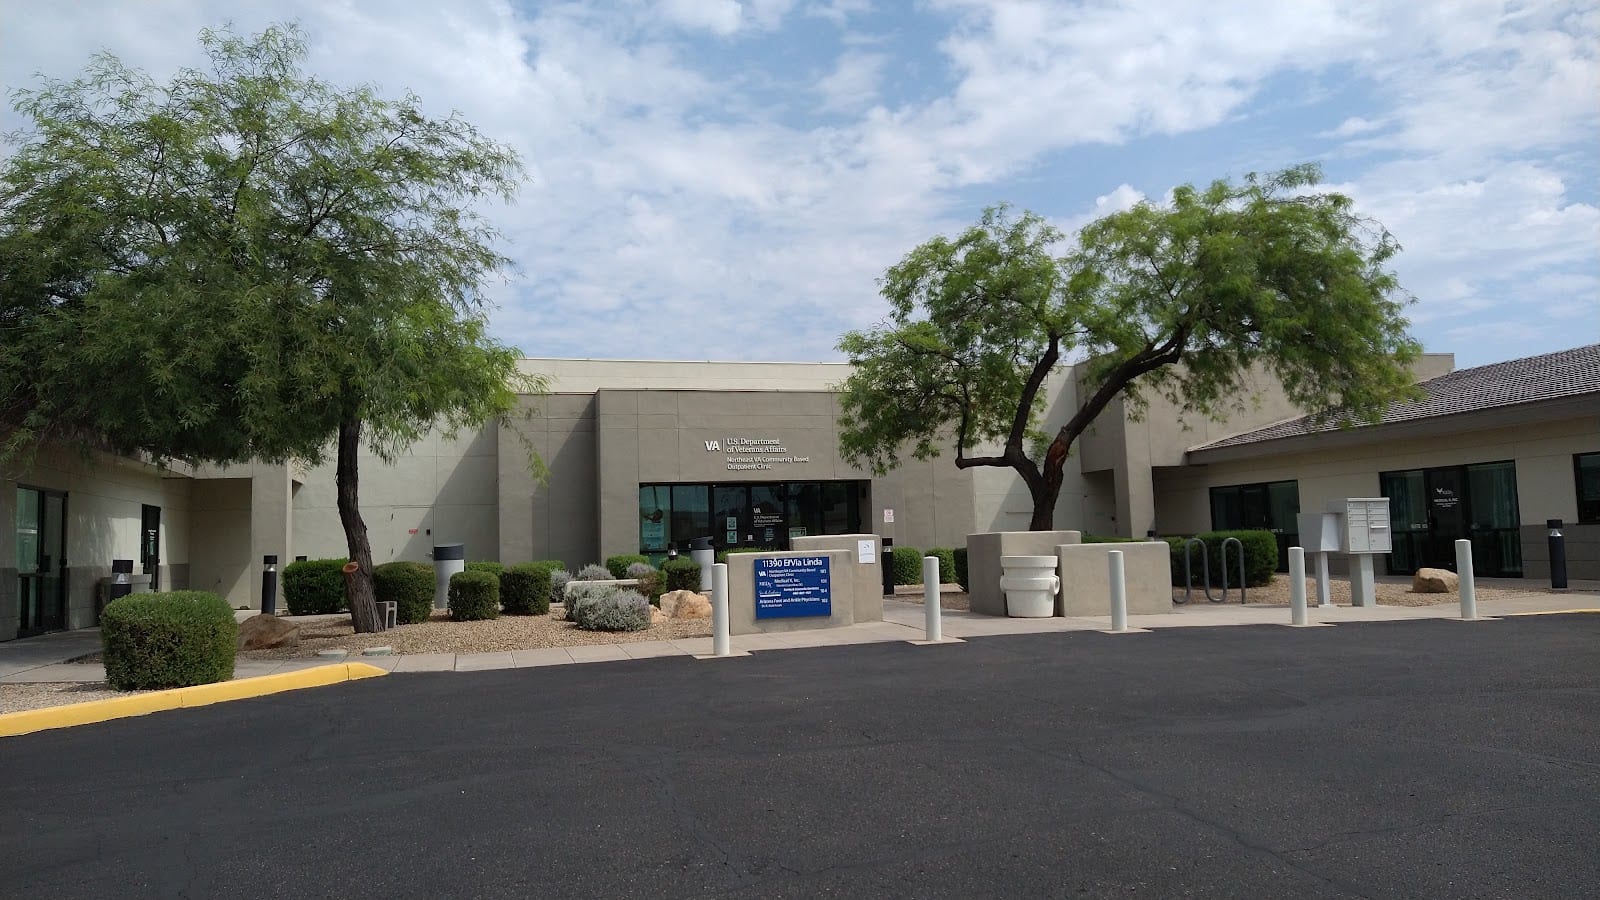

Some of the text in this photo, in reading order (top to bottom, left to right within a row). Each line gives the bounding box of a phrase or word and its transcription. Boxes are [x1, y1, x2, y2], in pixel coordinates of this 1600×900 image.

[704, 440, 720, 451] VA
[726, 438, 780, 447] U.S. Department
[762, 456, 793, 464] Community
[727, 464, 756, 472] Outpatient
[762, 558, 782, 568] 11390
[790, 558, 802, 566] Via
[803, 558, 823, 566] Linda
